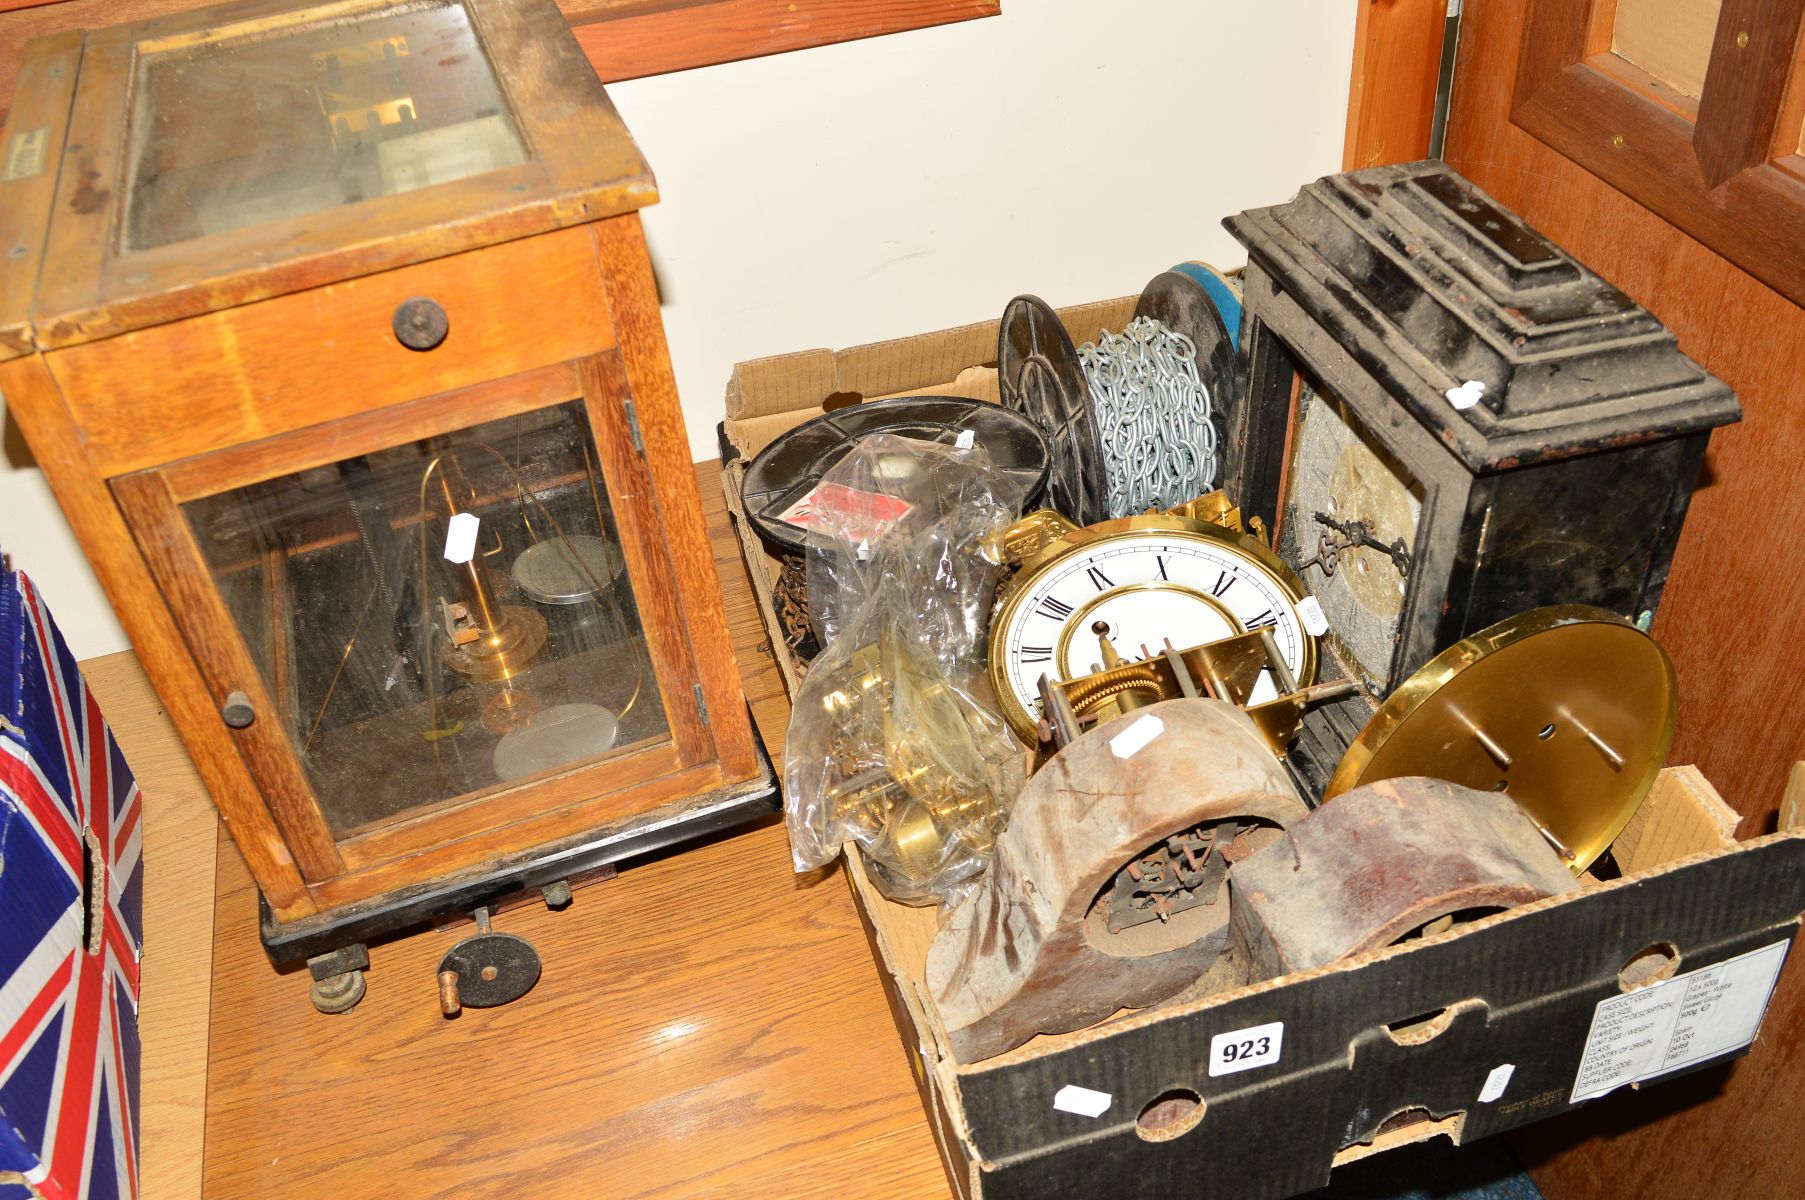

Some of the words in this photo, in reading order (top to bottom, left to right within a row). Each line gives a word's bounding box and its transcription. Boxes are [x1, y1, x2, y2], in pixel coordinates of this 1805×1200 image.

[1686, 991, 1708, 1002] Grapes
[1713, 983, 1732, 992] White
[1601, 997, 1634, 1013] PRODUCT
[1634, 991, 1655, 1003] CODE:
[1683, 1000, 1702, 1010] Sweet
[1598, 1011, 1616, 1022] CASE
[1680, 1009, 1698, 1018] 500g
[1596, 1016, 1628, 1030] PRODUCT
[1675, 1026, 1692, 1036] Spain
[1592, 1036, 1608, 1047] UNIT
[1608, 1032, 1622, 1042] SIZE
[1673, 1036, 1681, 1044] 10
[1682, 1032, 1695, 1040] Oct
[1222, 1036, 1271, 1063] 923
[1587, 1048, 1618, 1064] COUNTRY
[1618, 1046, 1630, 1054] OF
[1582, 1066, 1612, 1080] SUPPLIER
[1584, 1064, 1594, 1072] BB
[1580, 1078, 1600, 1088] DEFRA
